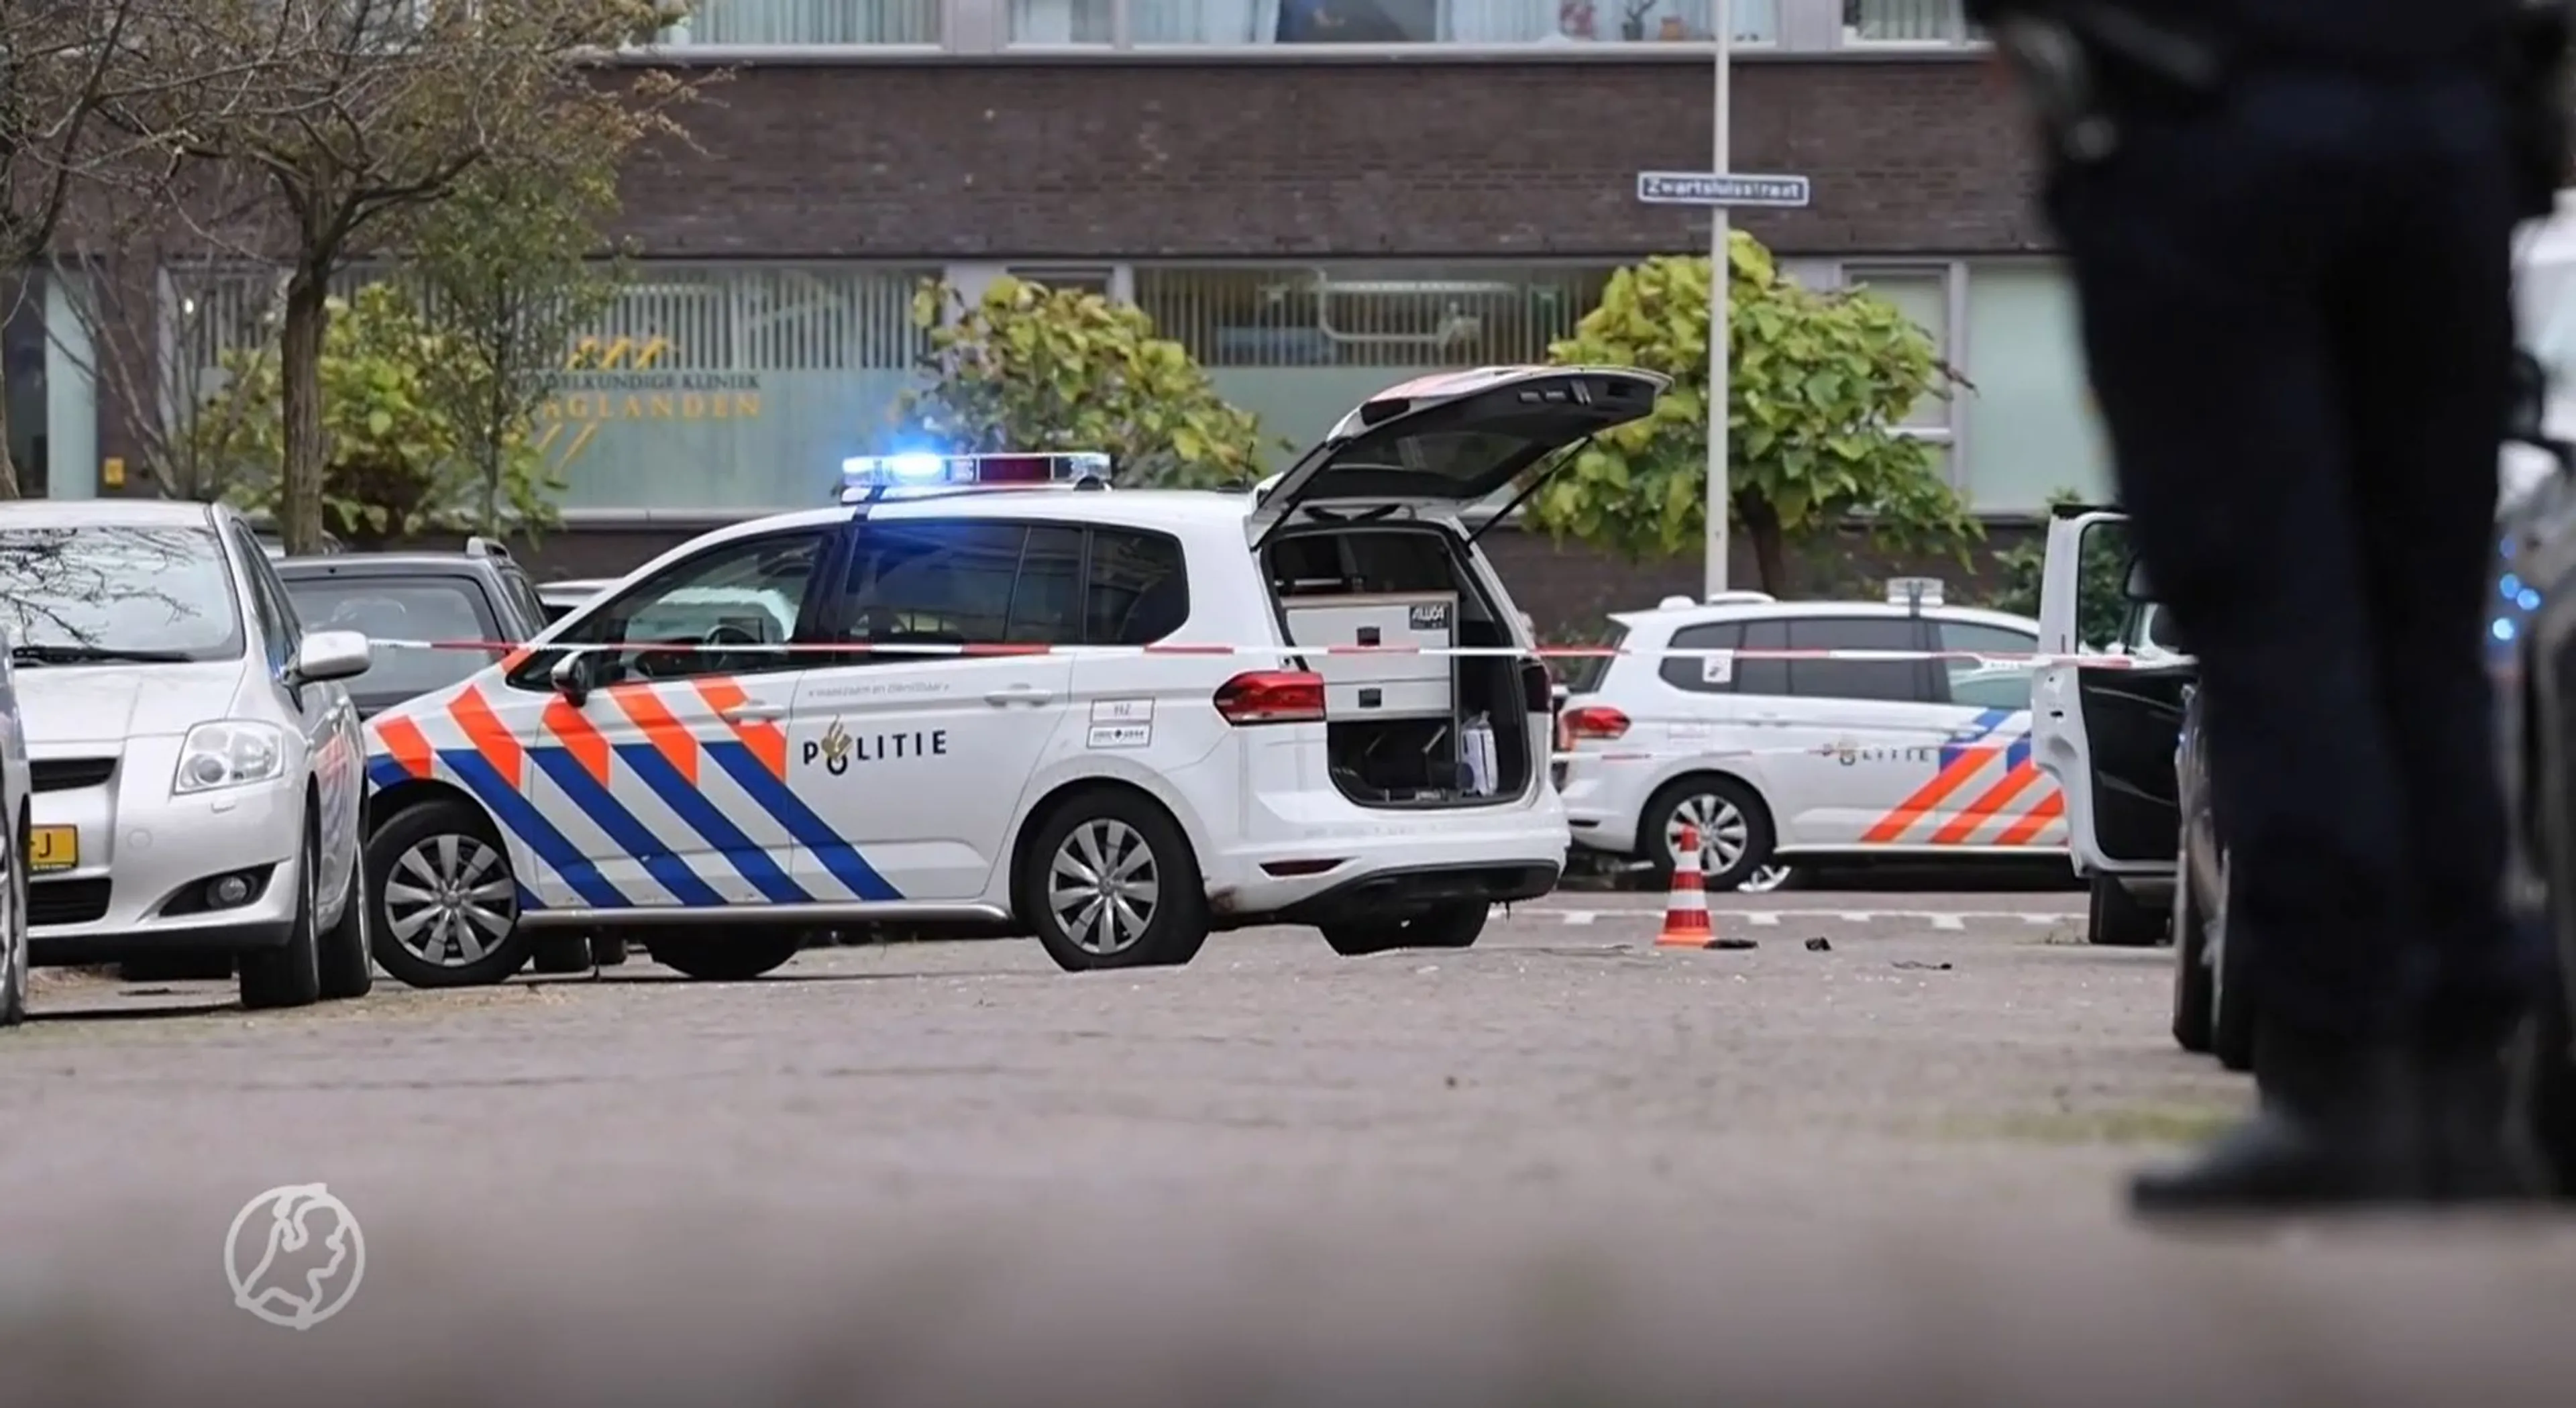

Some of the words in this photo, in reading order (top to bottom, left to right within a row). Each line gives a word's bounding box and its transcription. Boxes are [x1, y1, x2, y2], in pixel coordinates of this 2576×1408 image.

[1646, 177, 1800, 198] Zwartsluisstraat
[682, 373, 761, 390] KLINIEK
[803, 730, 947, 776] POLITIE
